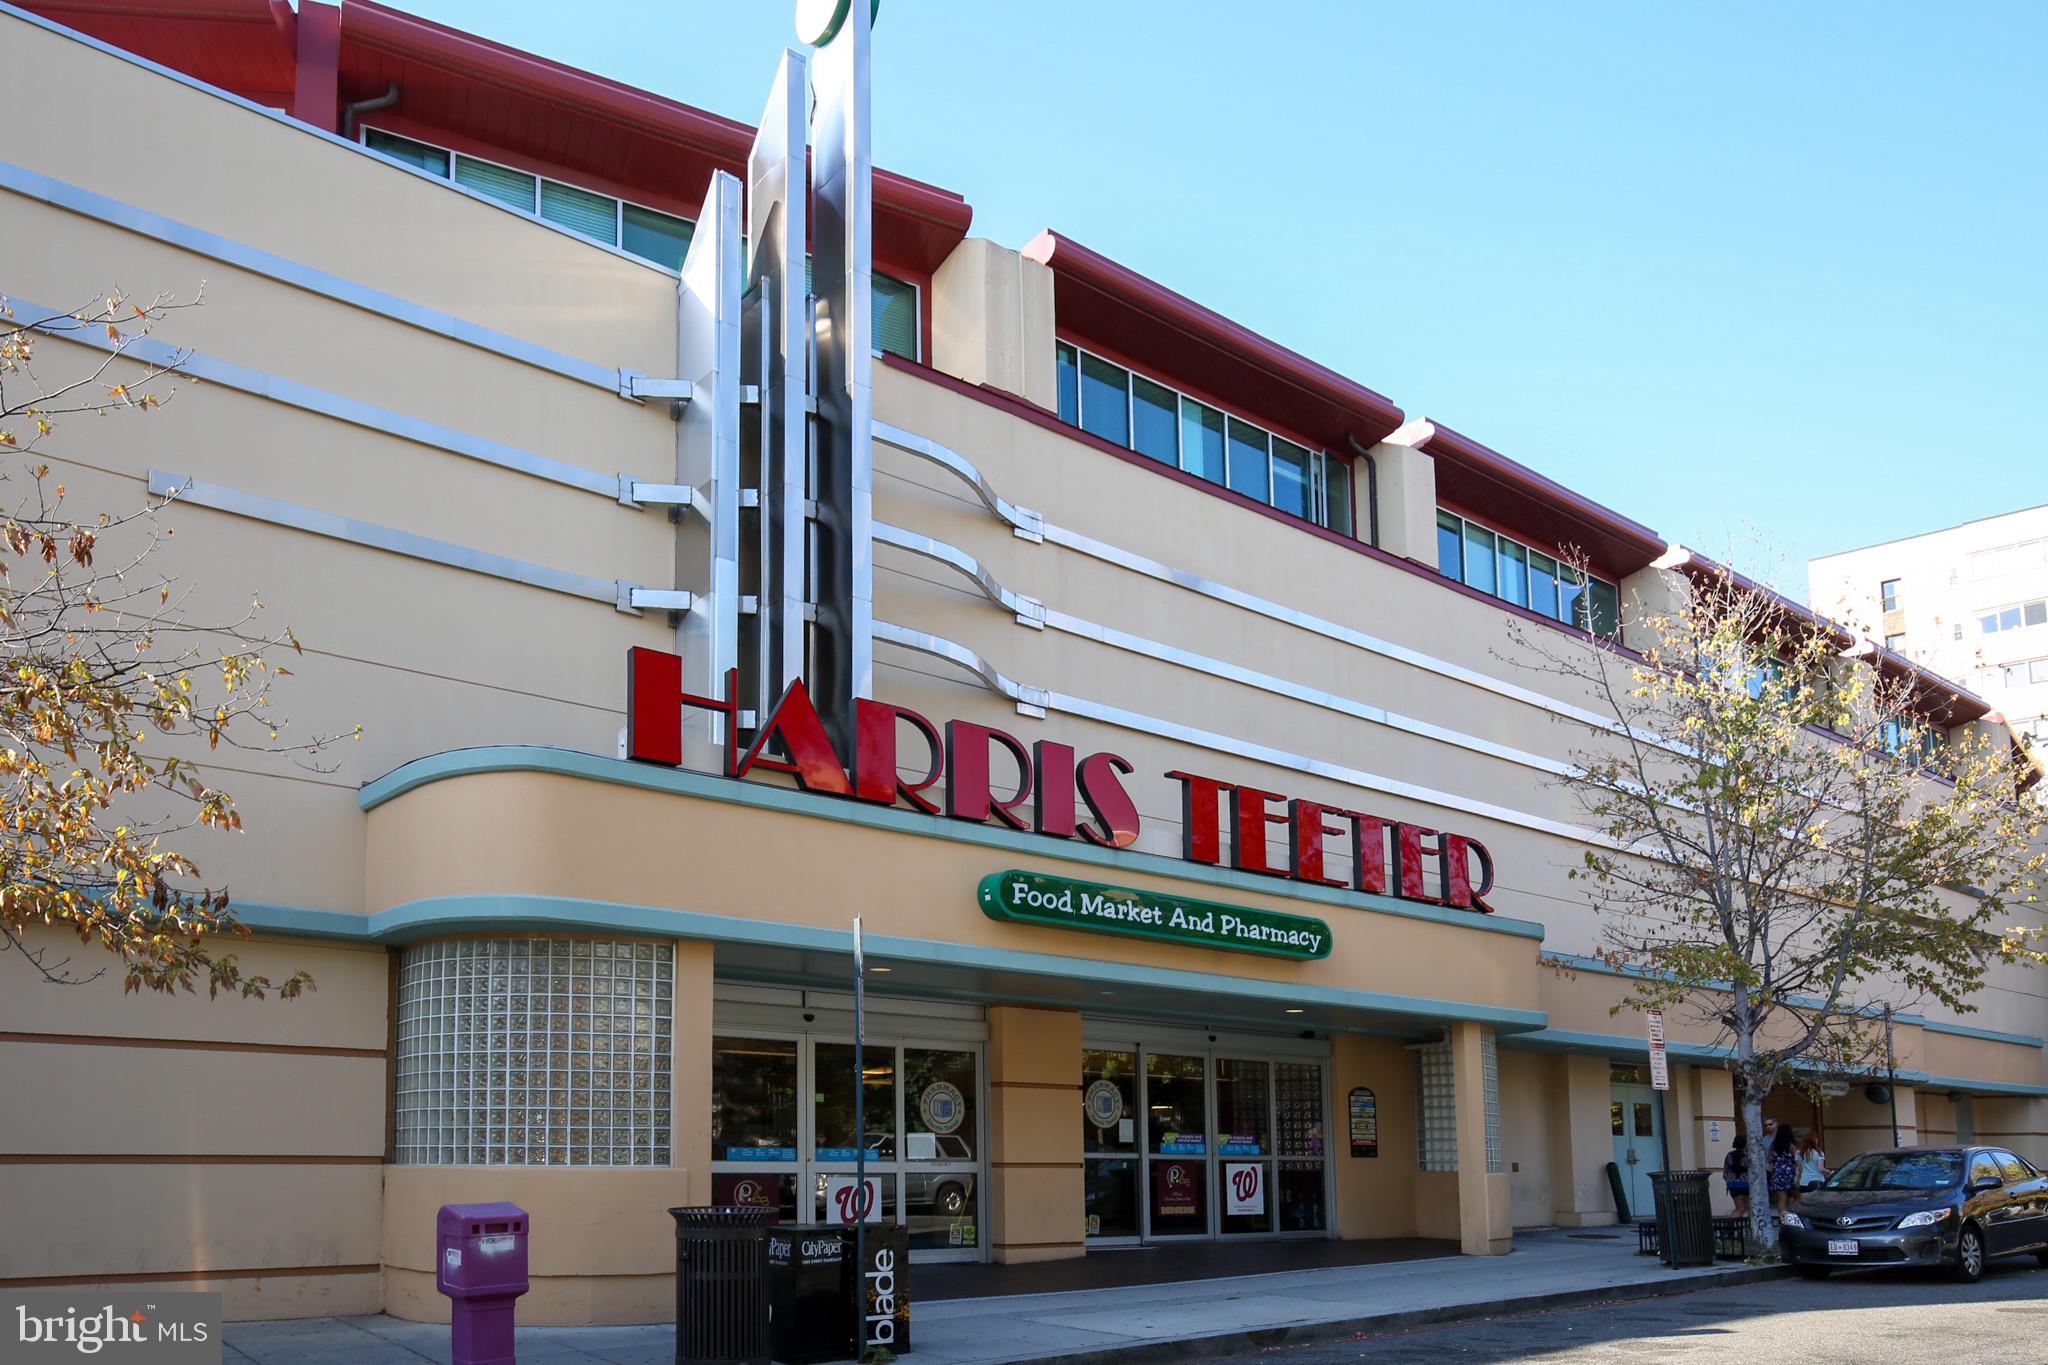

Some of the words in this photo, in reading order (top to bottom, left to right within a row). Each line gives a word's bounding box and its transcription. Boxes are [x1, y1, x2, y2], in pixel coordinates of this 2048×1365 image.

[627, 646, 1140, 849] HARRIS
[1164, 769, 1495, 914] TEETER
[1012, 883, 1074, 913] Food
[1081, 893, 1163, 924] Market
[1168, 908, 1215, 934] And
[1220, 915, 1322, 953] Pharmacy
[865, 1249, 894, 1345] blade
